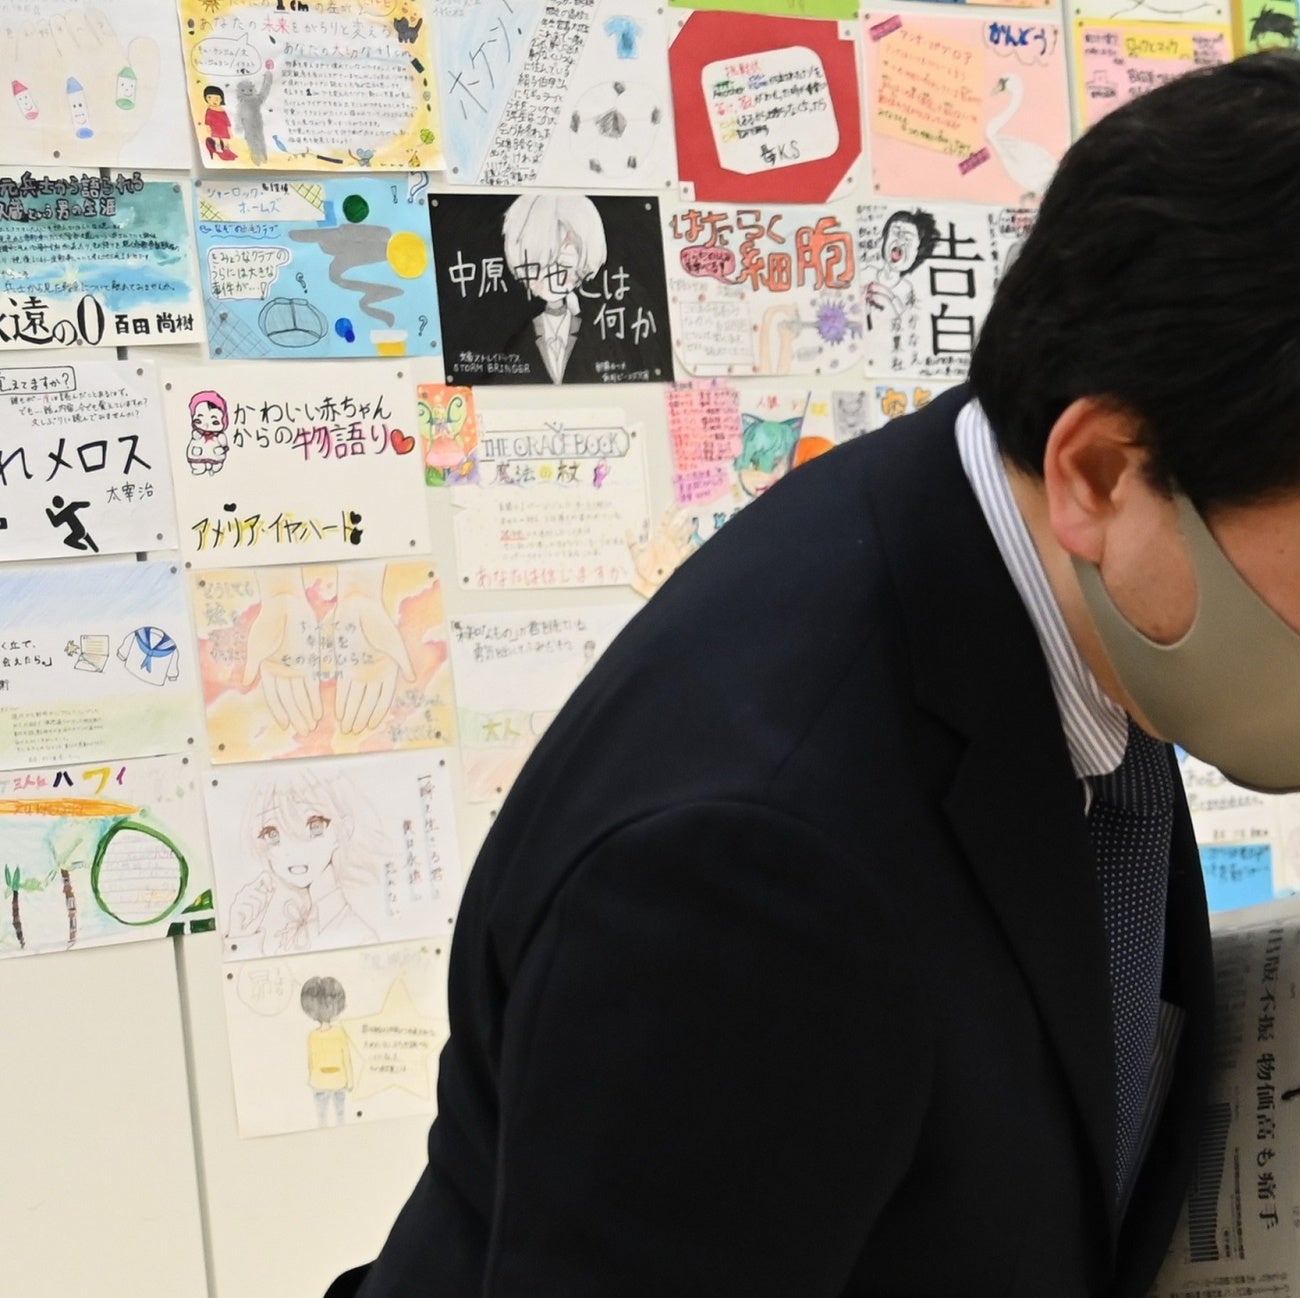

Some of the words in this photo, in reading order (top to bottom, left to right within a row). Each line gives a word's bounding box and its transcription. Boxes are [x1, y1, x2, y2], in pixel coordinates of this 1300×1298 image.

[672, 208, 787, 248] はたらく
[737, 215, 857, 293] 細胞
[448, 249, 631, 302] 中原中也とは
[929, 220, 985, 356] 告白
[115, 314, 150, 335] 百田
[593, 303, 657, 345] 何か
[453, 363, 484, 374] STORM
[487, 363, 531, 374] BRINGER
[234, 394, 392, 426] かわいい赤ちゃん
[232, 421, 390, 460] からの物語り
[481, 436, 512, 458] THE
[573, 431, 622, 457] BOOK
[106, 481, 154, 503] 太宰治
[1255, 1051, 1280, 1231] 物価高も痛手
